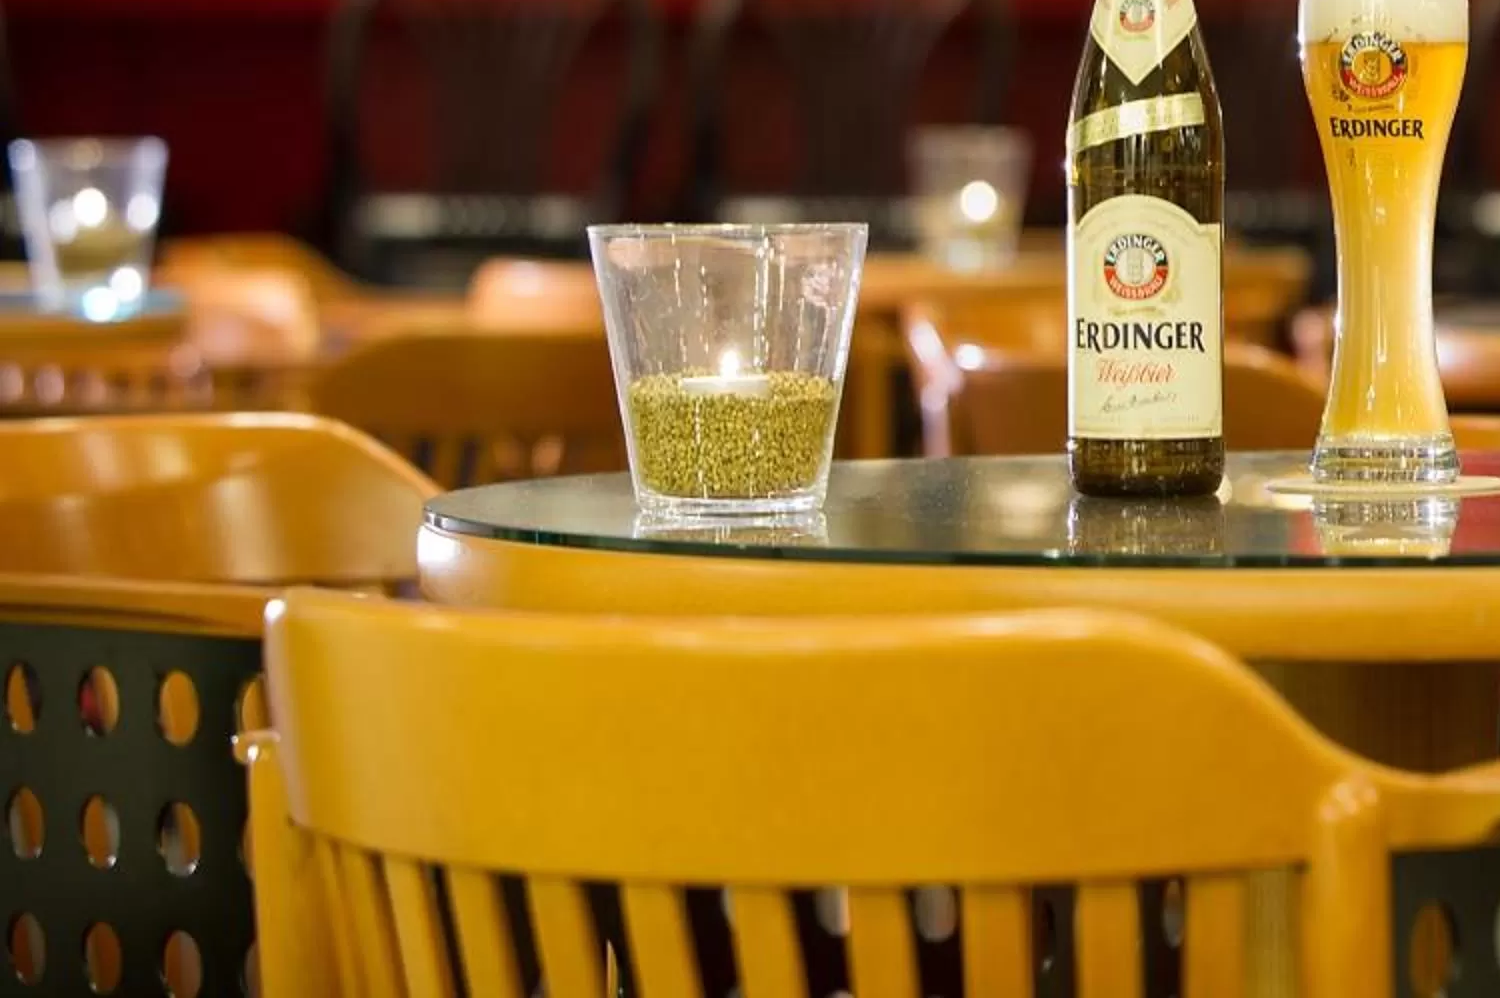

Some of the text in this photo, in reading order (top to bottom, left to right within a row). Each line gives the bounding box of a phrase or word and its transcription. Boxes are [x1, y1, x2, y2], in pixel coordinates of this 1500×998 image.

[1330, 116, 1424, 140] ERDINGER
[1105, 233, 1166, 263] ERDINGER
[1076, 317, 1205, 353] ERDINGER
